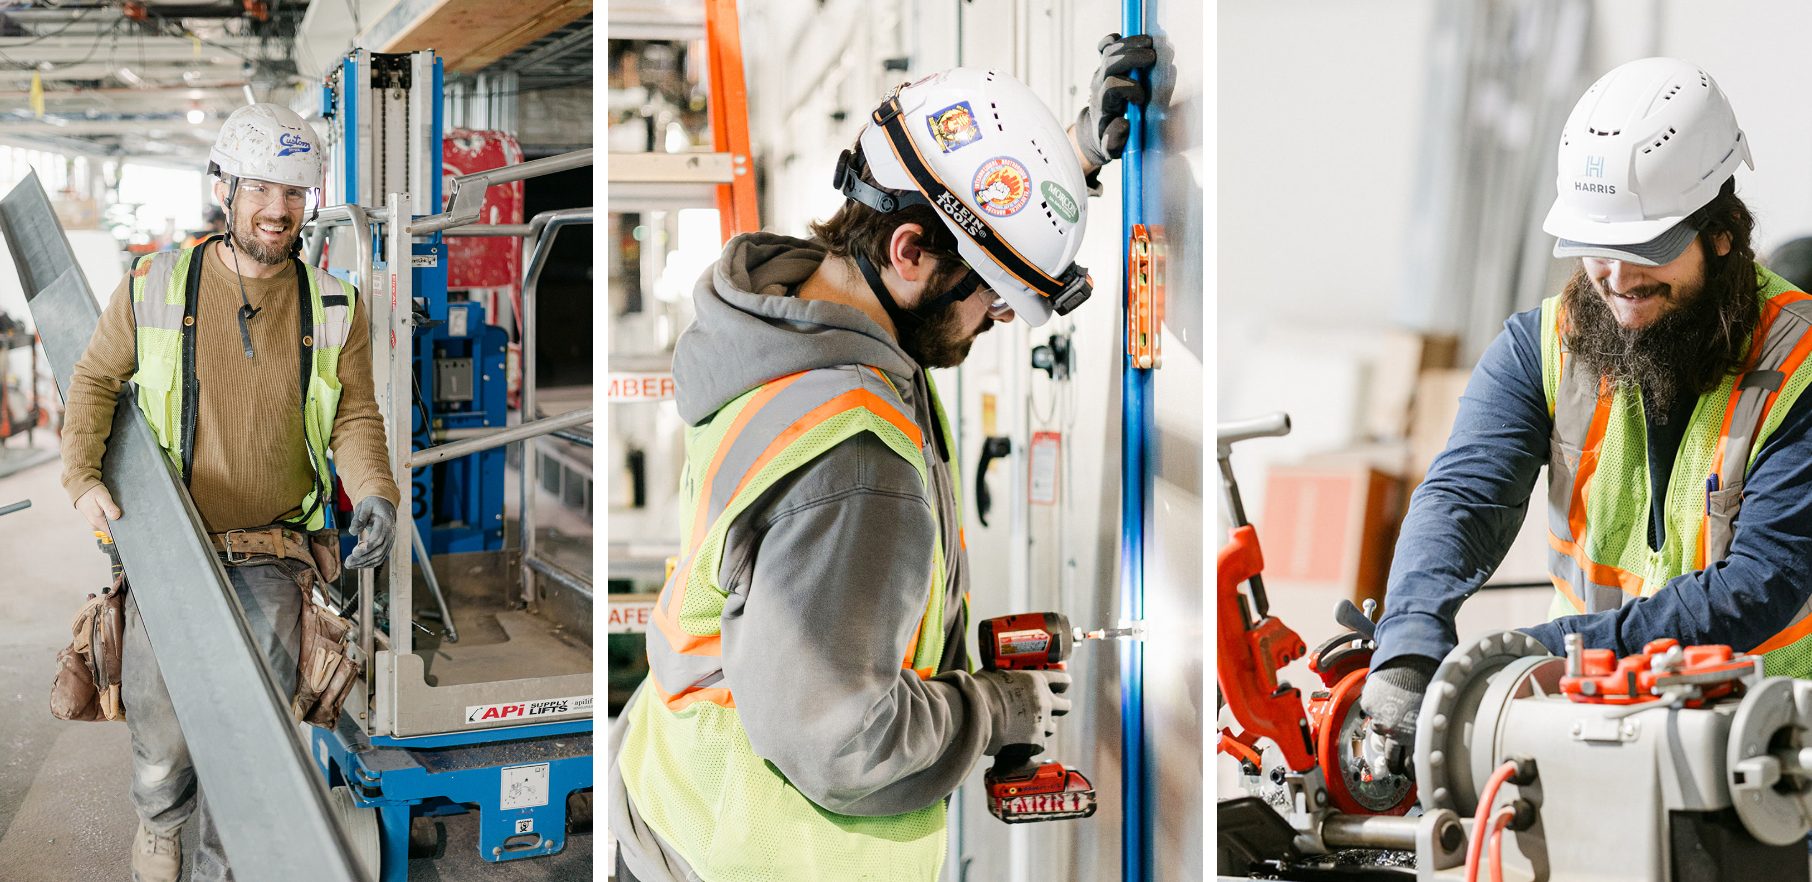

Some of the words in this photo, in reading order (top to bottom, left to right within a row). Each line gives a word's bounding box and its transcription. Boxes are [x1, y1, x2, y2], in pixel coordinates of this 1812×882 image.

[280, 132, 310, 147] Custom
[1575, 181, 1616, 194] HARRIS
[1048, 183, 1078, 215] MORCON
[940, 190, 984, 230] KLEIN
[608, 608, 654, 624] AFE
[529, 705, 568, 715] LIFTS
[531, 700, 568, 708] SUPPLY
